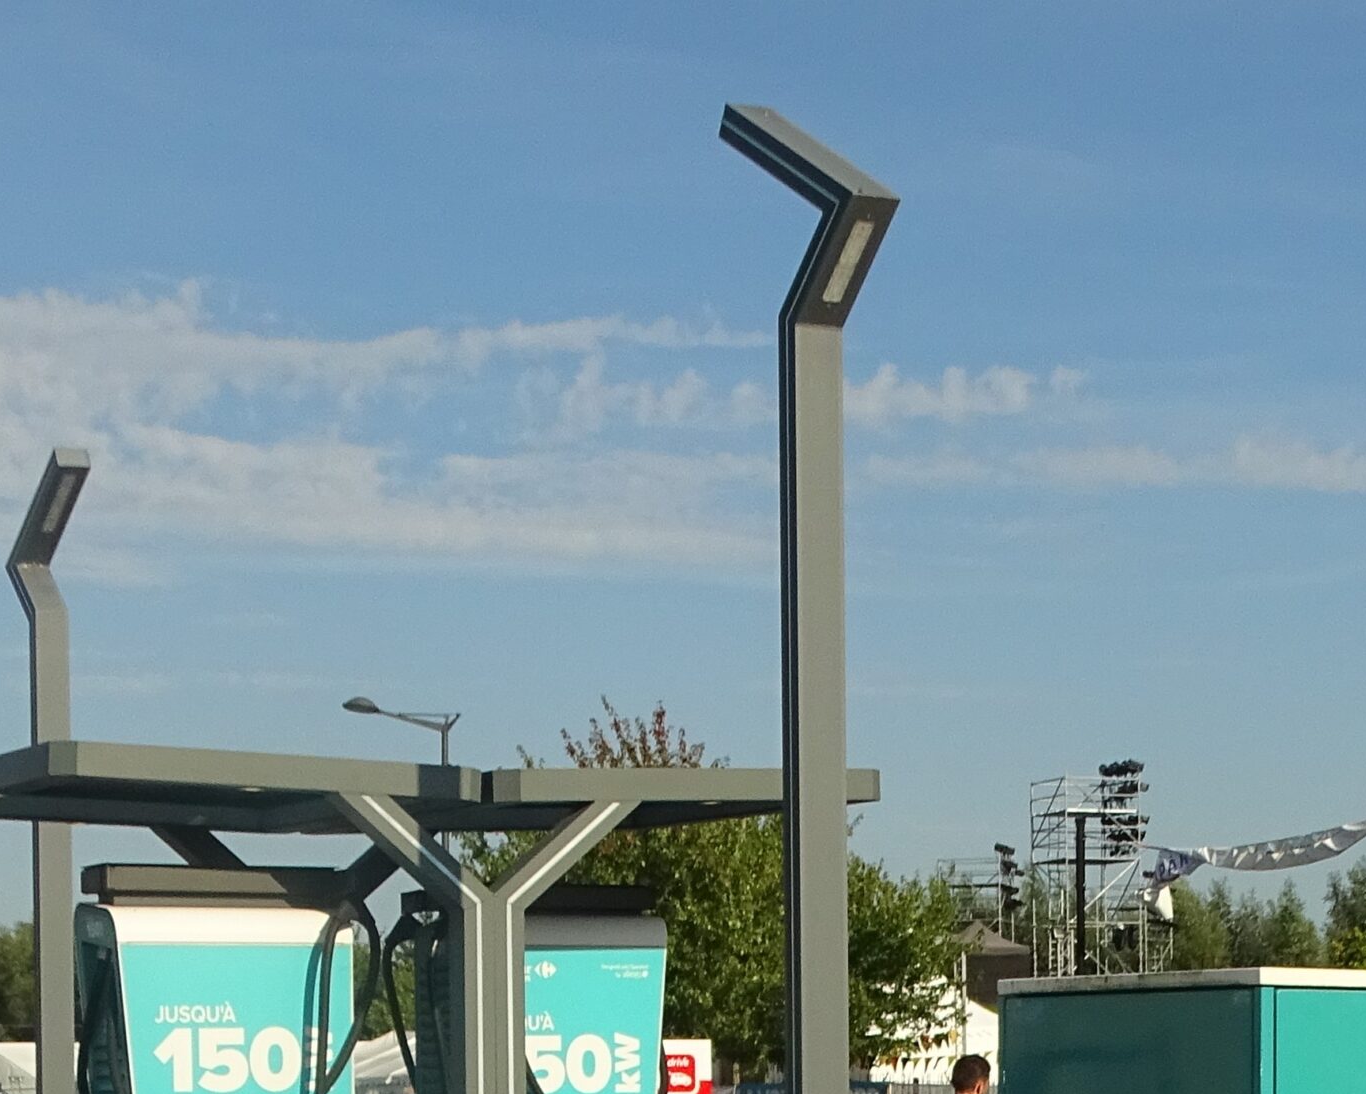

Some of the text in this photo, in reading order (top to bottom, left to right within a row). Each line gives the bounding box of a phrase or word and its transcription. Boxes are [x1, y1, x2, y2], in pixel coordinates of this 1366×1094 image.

[155, 1001, 235, 1024] JUSQU'À
[153, 1026, 302, 1092] 150
[524, 1032, 641, 1094] 50 kW
